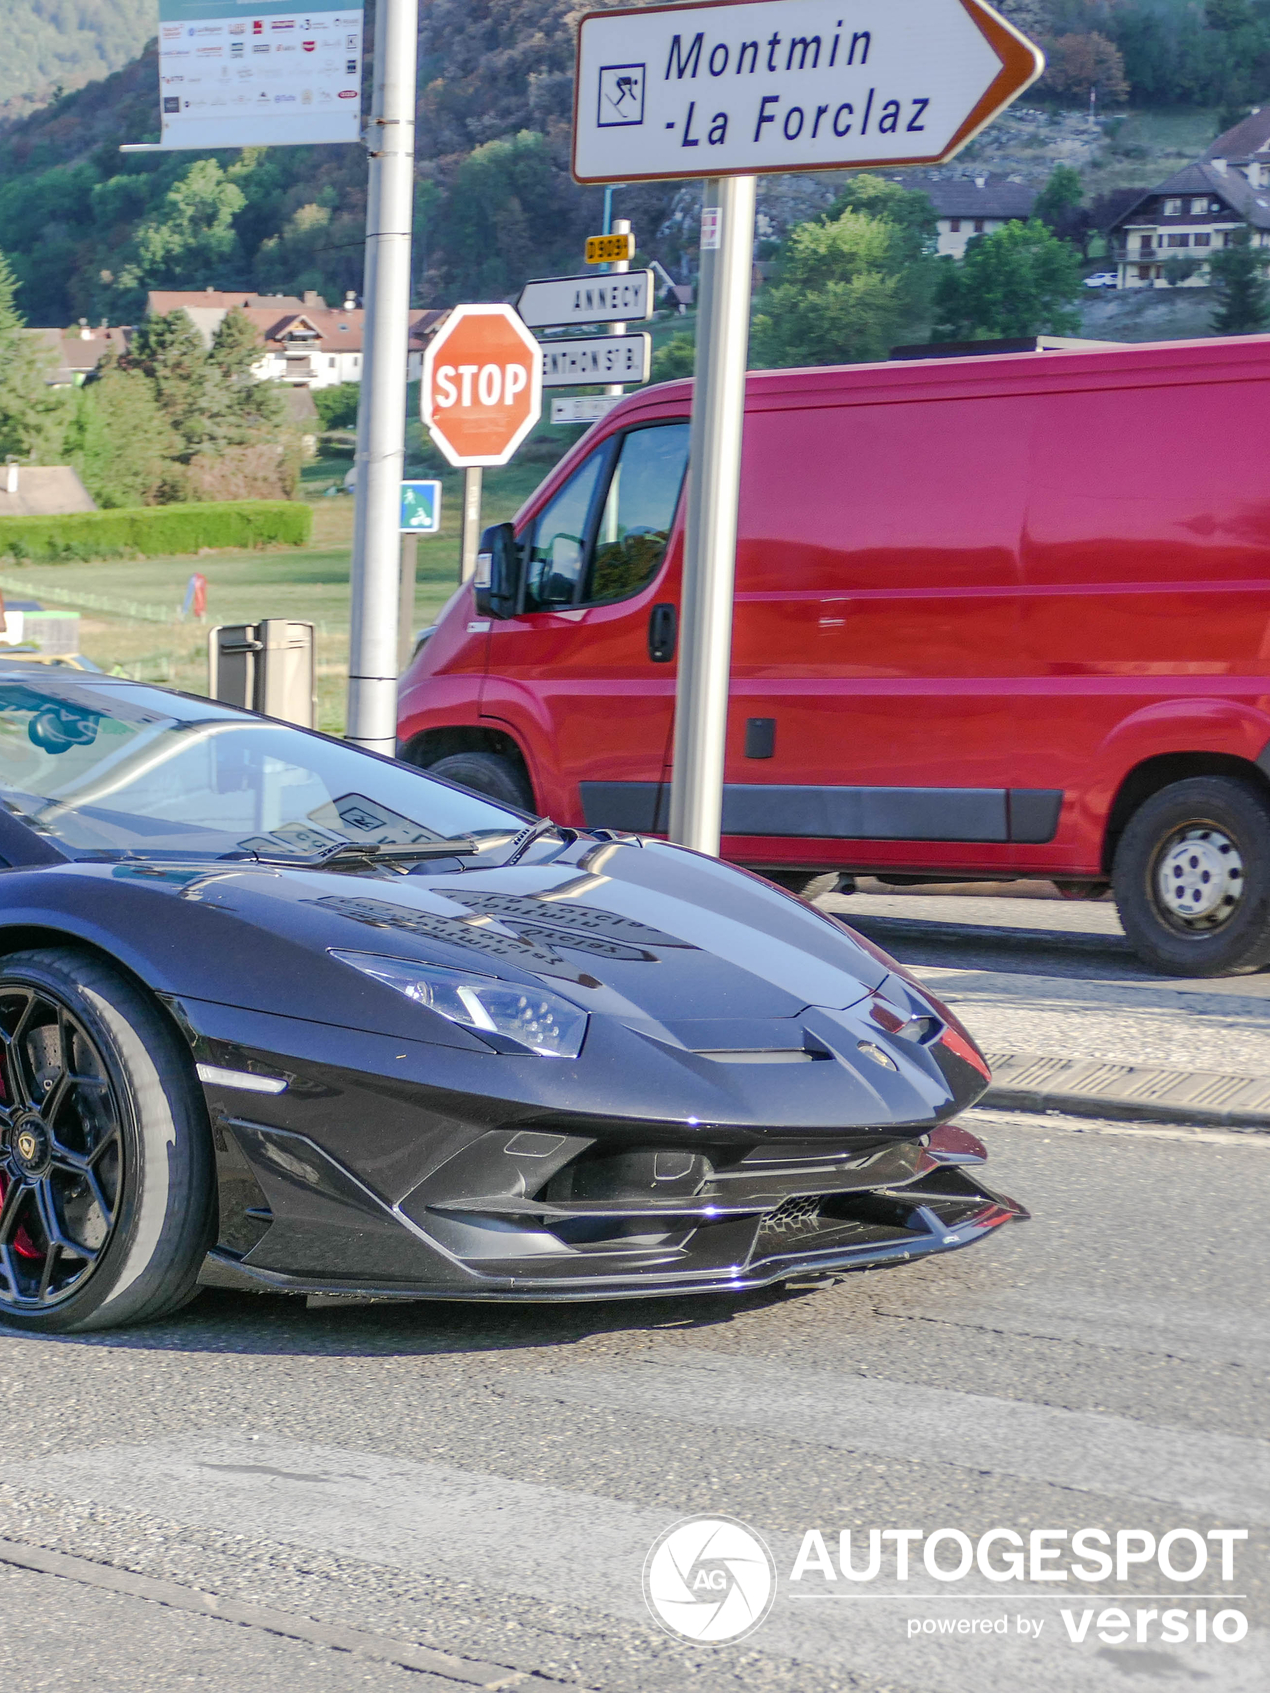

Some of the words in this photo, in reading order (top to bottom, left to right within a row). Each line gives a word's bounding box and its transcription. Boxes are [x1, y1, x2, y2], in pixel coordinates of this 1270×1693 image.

[664, 19, 872, 81] Montmin
[665, 101, 729, 148] -La
[752, 87, 931, 143] Forclaz
[571, 283, 643, 313] ANNECY
[435, 363, 528, 408] STOP
